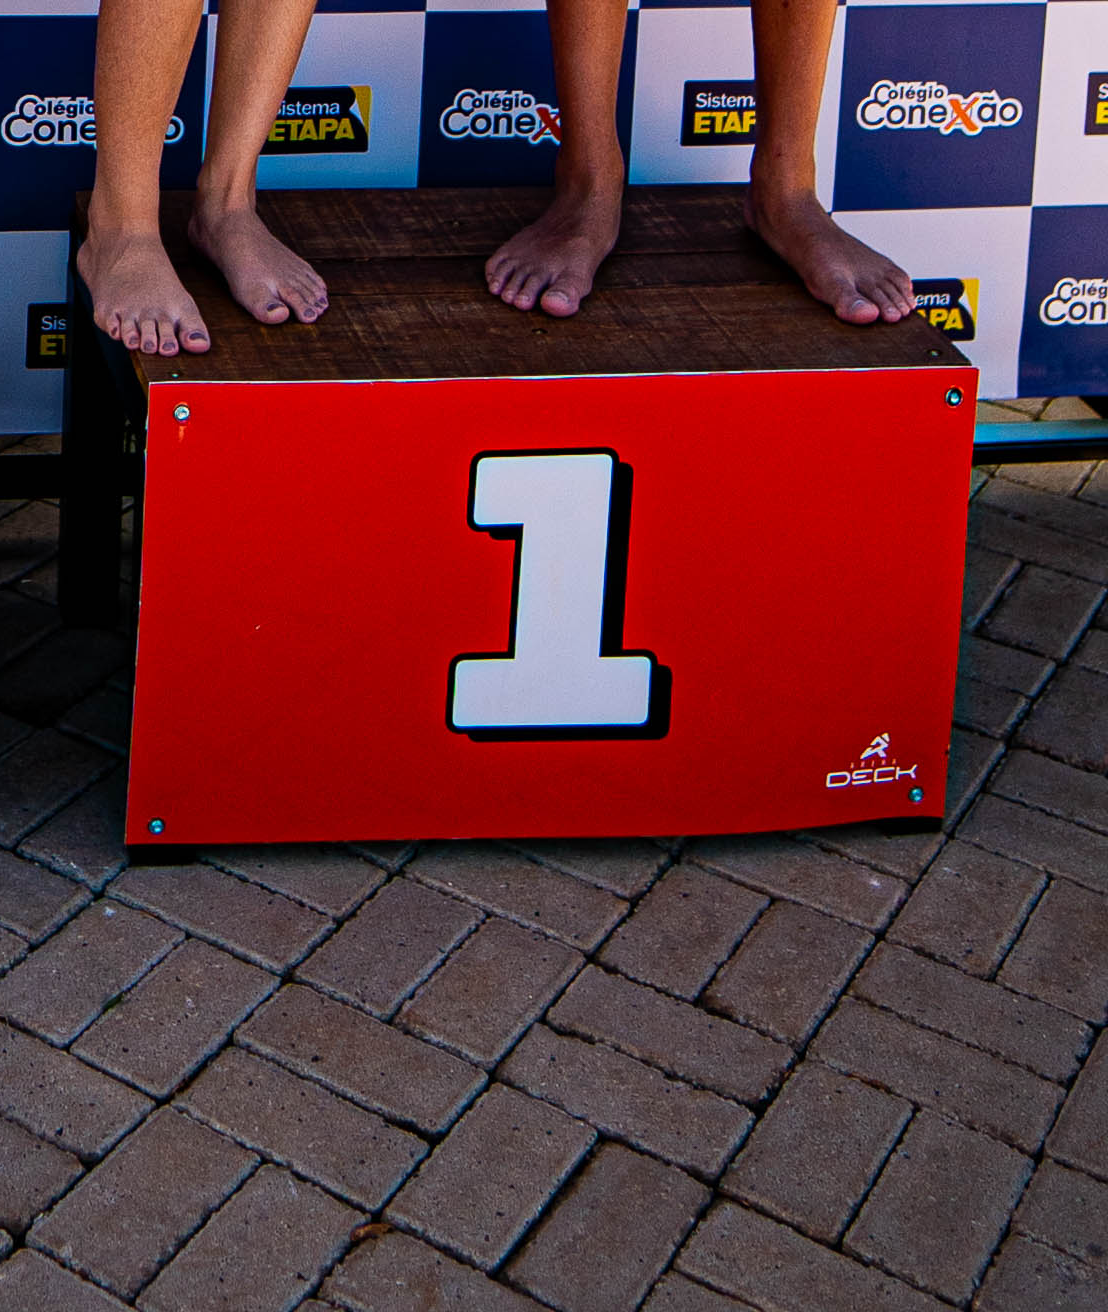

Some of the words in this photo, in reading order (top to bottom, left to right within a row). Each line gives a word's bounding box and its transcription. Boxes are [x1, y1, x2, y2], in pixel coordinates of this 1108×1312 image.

[457, 92, 532, 112] Colégio
[696, 93, 755, 108] Sistem
[875, 82, 944, 104] Colégio
[20, 97, 94, 119] Colégio
[448, 450, 660, 734] 1
[826, 764, 918, 788] DECK
